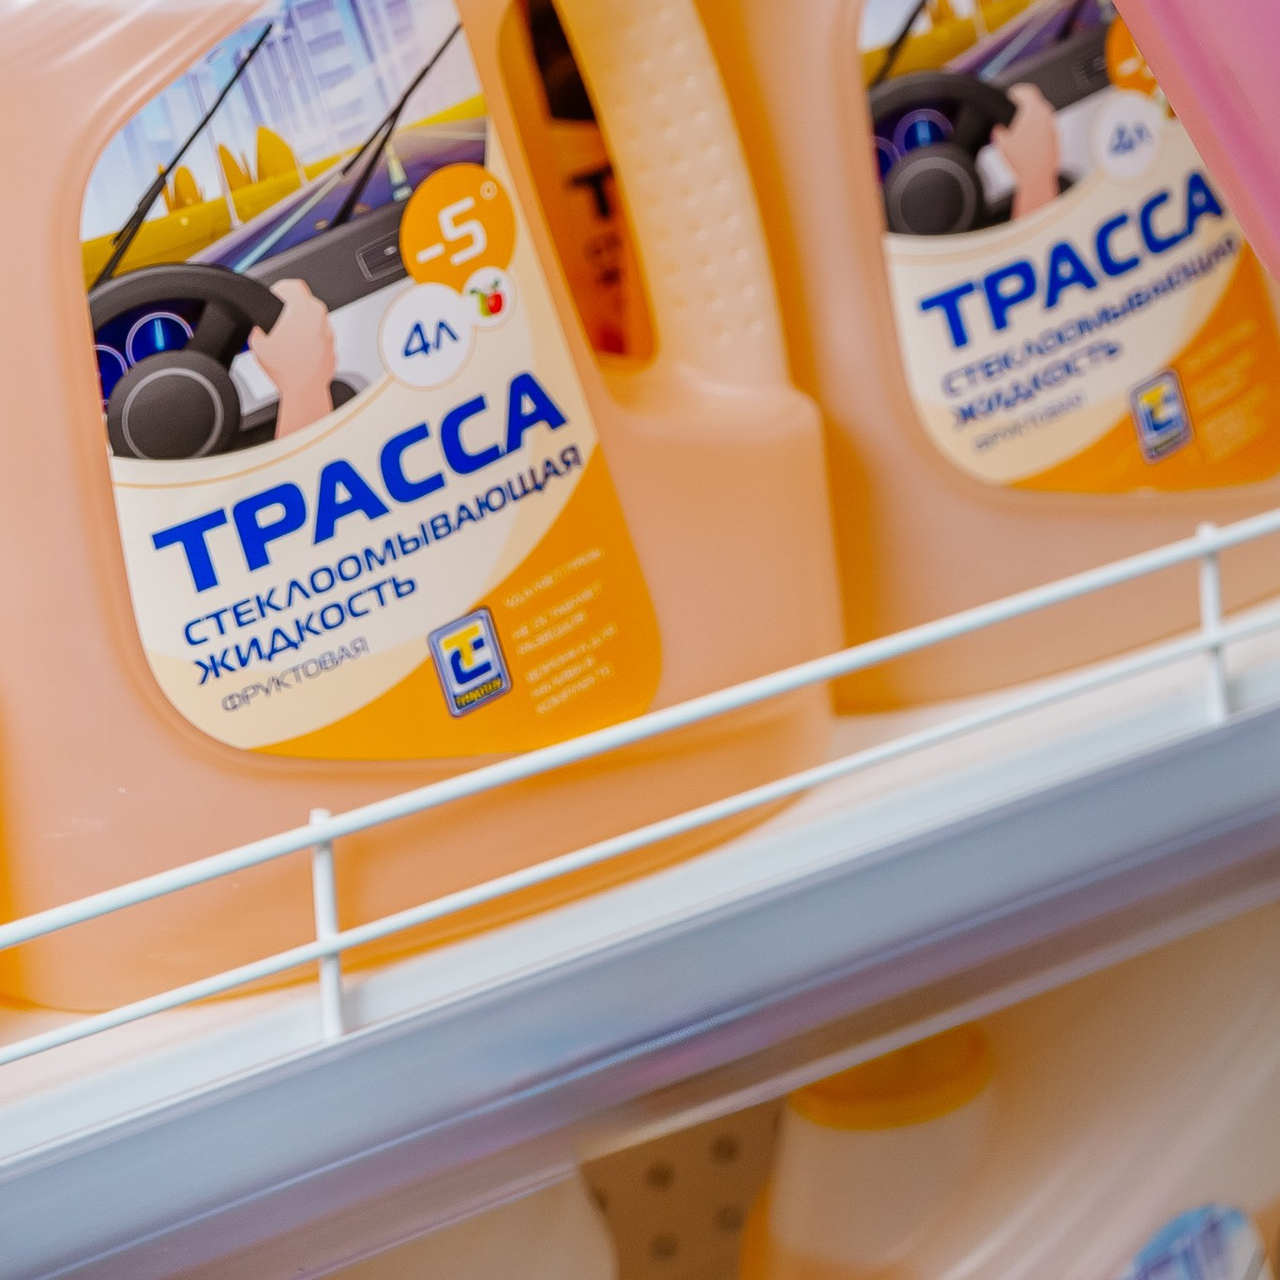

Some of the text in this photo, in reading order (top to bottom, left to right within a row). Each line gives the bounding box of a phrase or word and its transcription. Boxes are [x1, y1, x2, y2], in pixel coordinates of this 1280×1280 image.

[921, 173, 1225, 349] ТРАССА
[151, 372, 568, 594] ТРАССА
[183, 445, 583, 647] СТЕКЛООМЫВАЮЩАЯ
[194, 574, 418, 686] ЖИДКОСТЬ
[221, 637, 369, 715] ФРУКТОВАЯ
